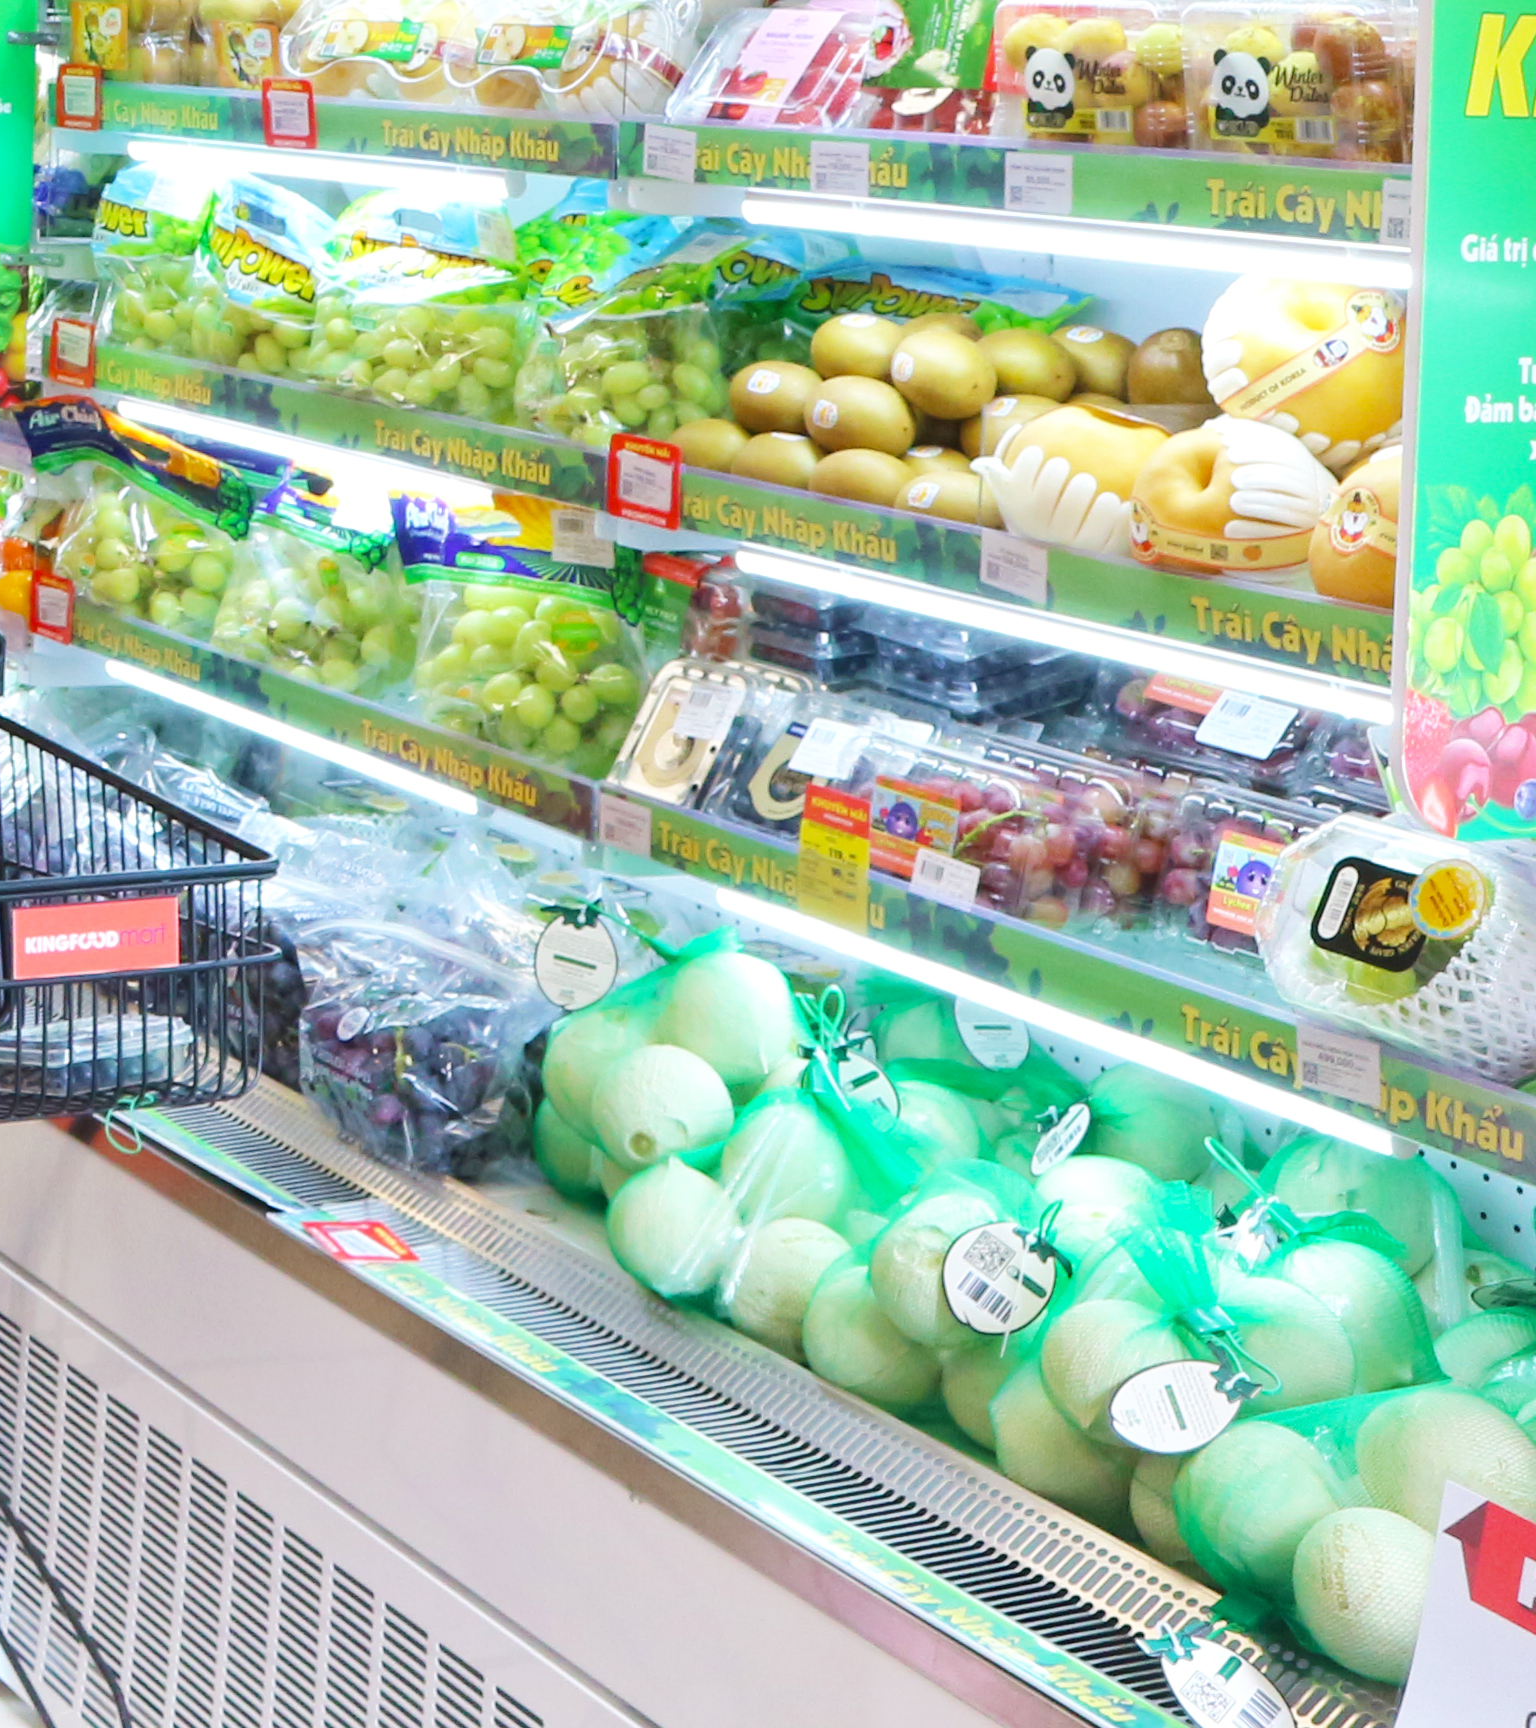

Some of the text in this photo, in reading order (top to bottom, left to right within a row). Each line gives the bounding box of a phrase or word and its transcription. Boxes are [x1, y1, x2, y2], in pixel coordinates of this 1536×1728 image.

[1270, 65, 1326, 88] Winter
[509, 127, 559, 162] Khẩu
[727, 141, 766, 182] Cây
[1206, 178, 1266, 219] Trái
[1275, 184, 1335, 234] Cây
[1460, 233, 1528, 269] Giá trị
[1464, 393, 1514, 423] Đảm
[501, 448, 551, 486] Khẩu
[716, 494, 897, 563] Cây Nhập Khẩu
[1191, 597, 1322, 665] Trái Cây
[658, 821, 745, 885] Trái Cây
[1180, 1004, 1240, 1060] Trái
[1426, 1089, 1525, 1163] Khẩu
